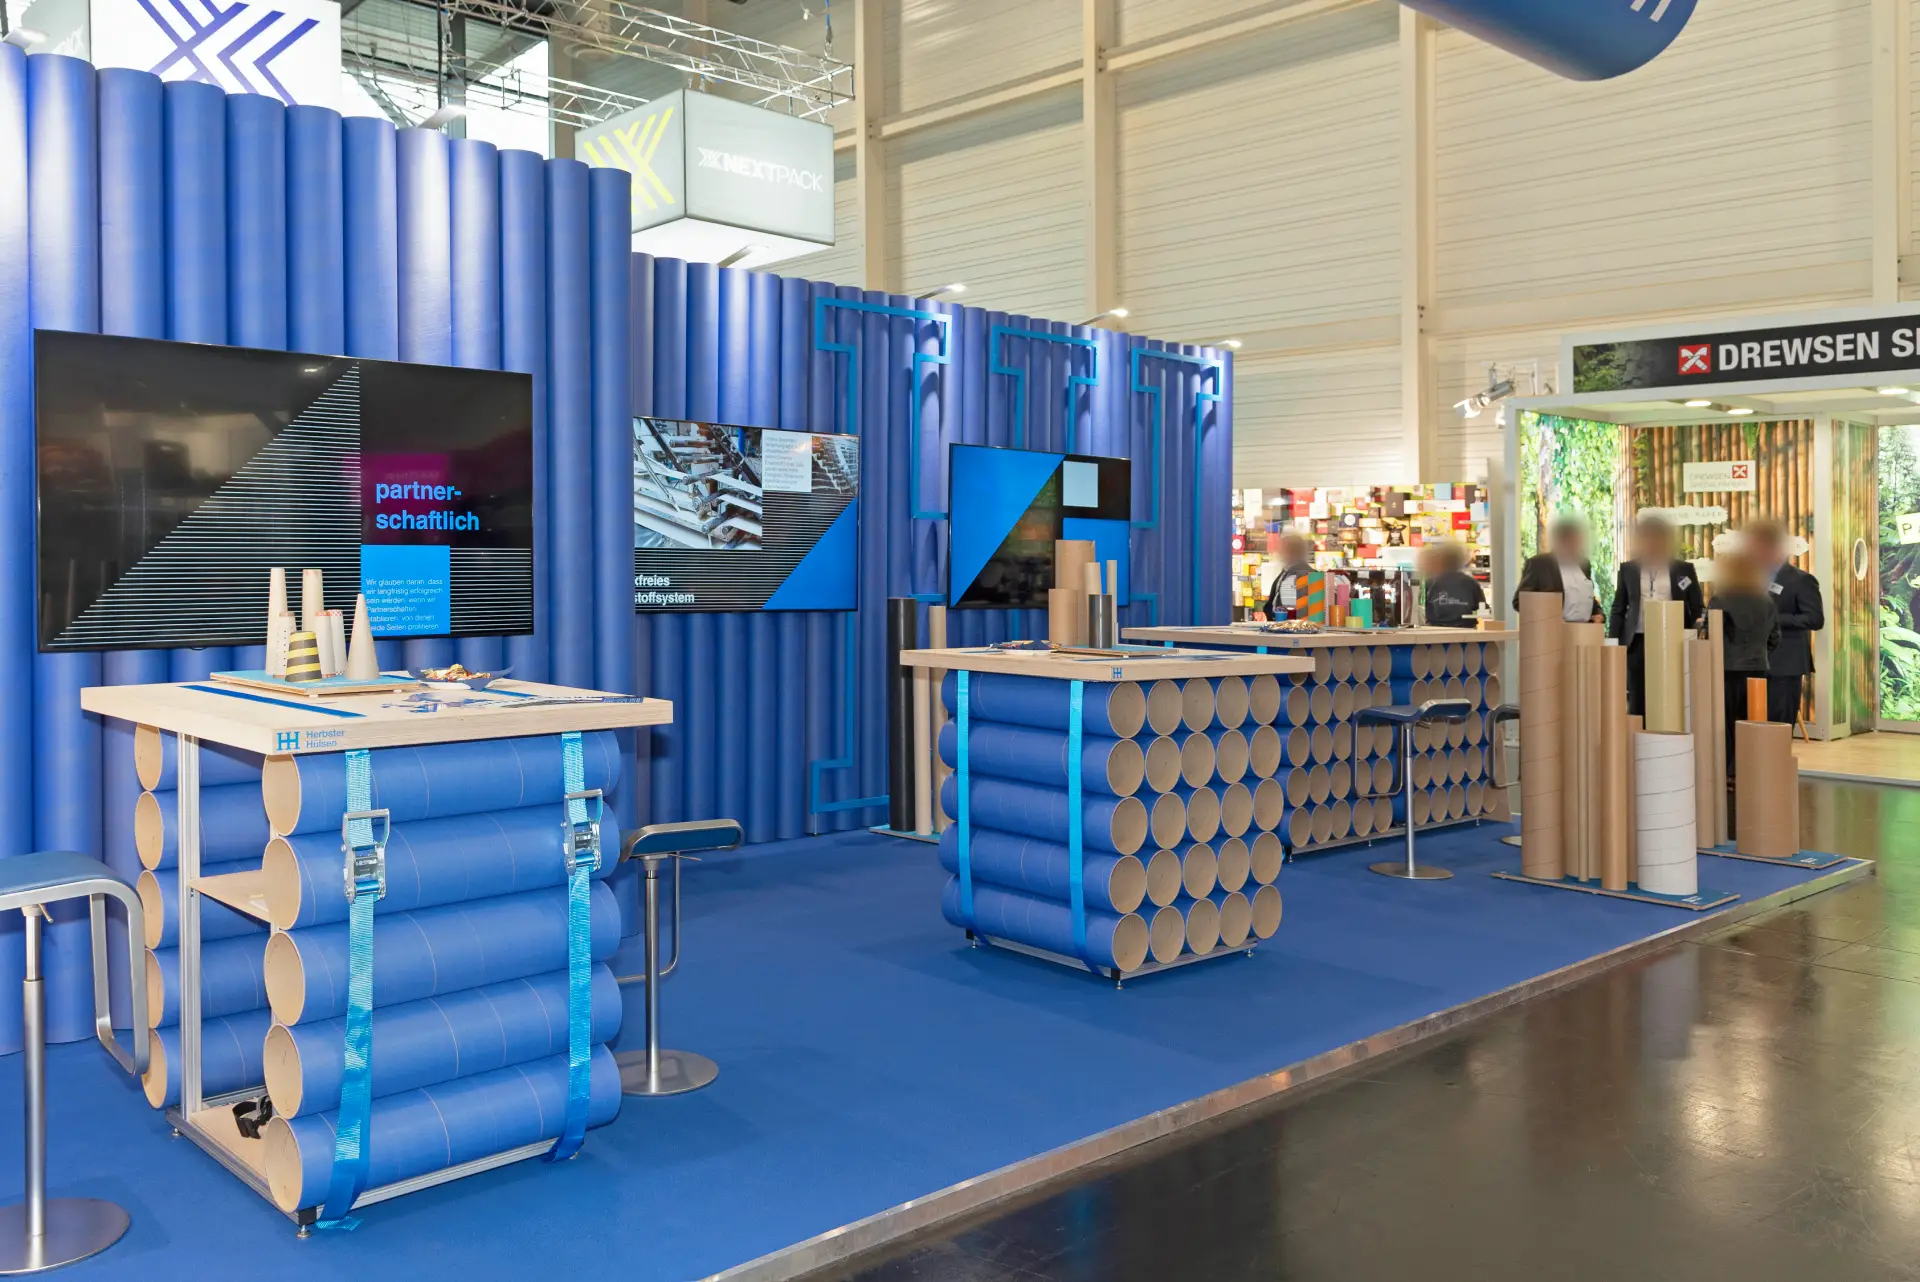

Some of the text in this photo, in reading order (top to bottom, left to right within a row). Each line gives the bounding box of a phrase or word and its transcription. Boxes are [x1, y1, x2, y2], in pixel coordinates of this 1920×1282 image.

[723, 152, 824, 192] NEXTPACK
[1719, 328, 1920, 371] DREWSEN S
[376, 481, 462, 504] partner-
[376, 509, 480, 531] schaftlich
[365, 578, 377, 586] Wir
[377, 587, 409, 596] langfristig
[410, 587, 443, 596] erfolgreich
[386, 623, 407, 631] Seiten
[306, 729, 346, 739] Herbster
[306, 739, 337, 748] Hülsen
